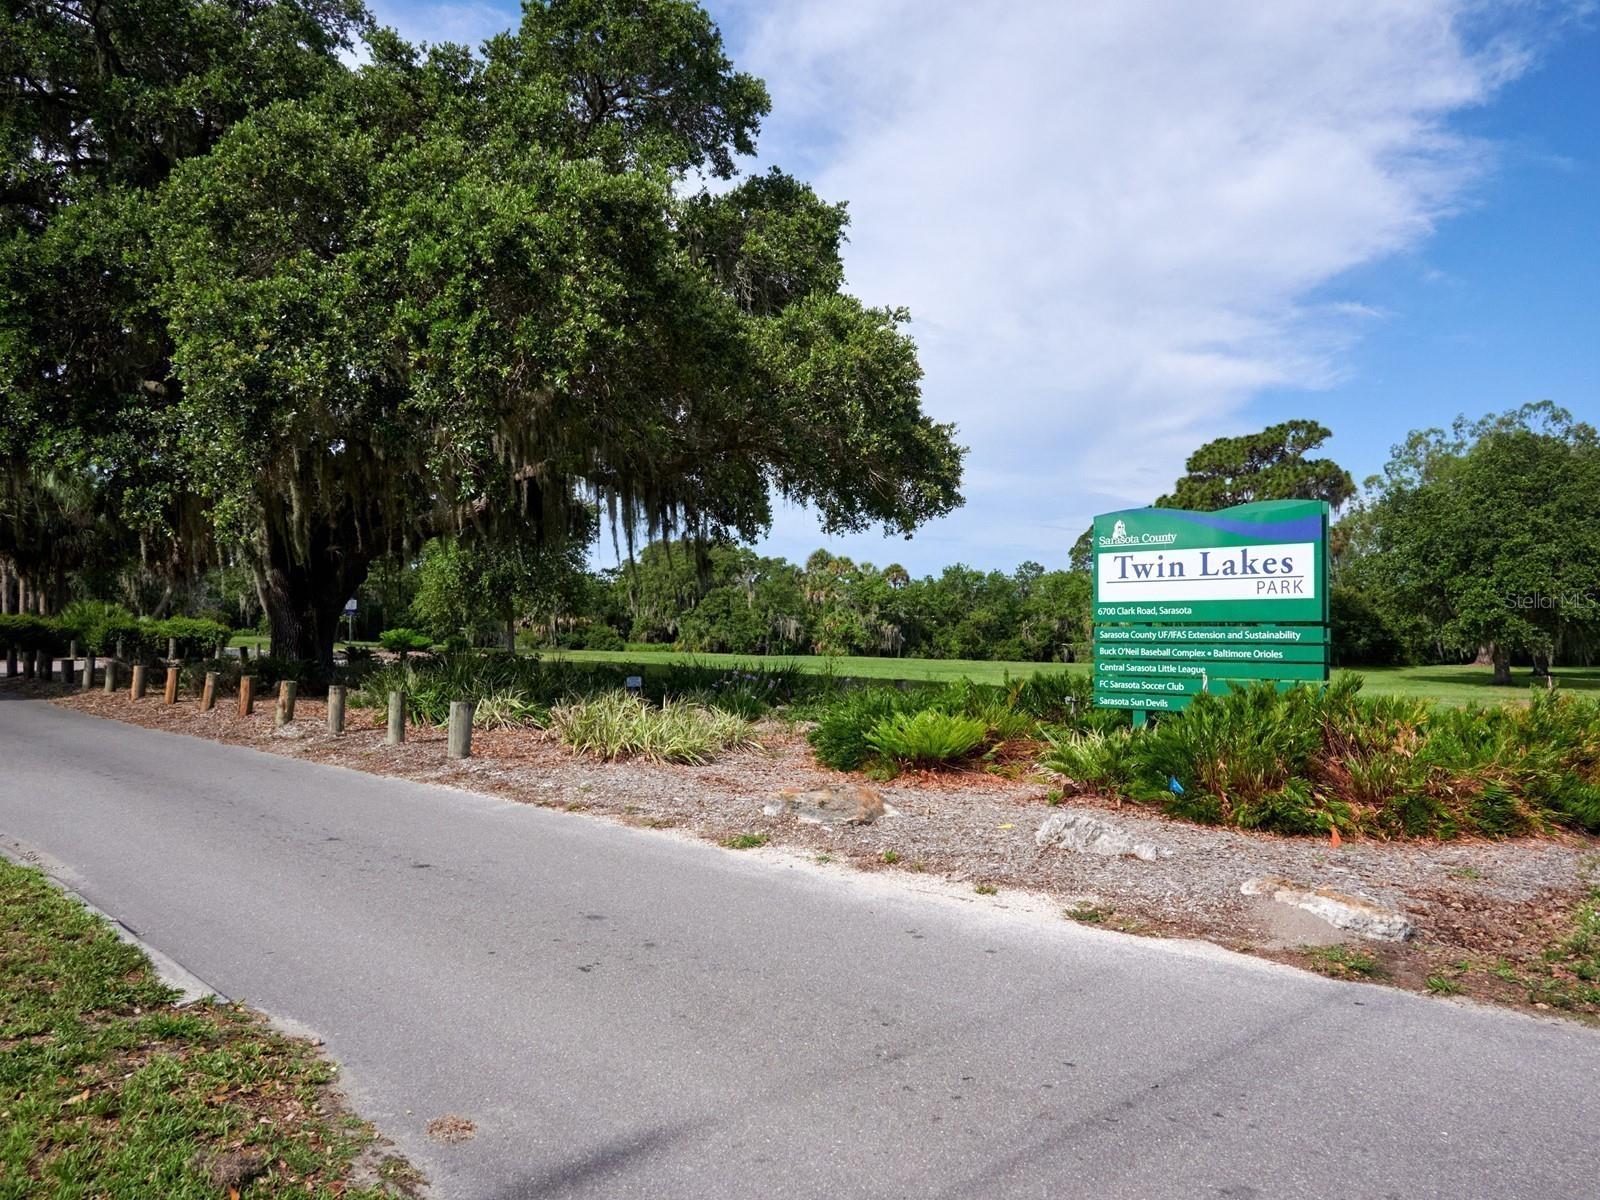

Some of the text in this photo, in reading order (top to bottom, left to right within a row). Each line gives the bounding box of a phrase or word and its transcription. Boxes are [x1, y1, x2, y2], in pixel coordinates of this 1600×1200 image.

[1099, 532, 1177, 546] Sarasota County
[1113, 548, 1294, 579] Twin Lakes
[1256, 579, 1304, 595] PARK
[1097, 606, 1192, 616] 6700 Clark Road, Sarasota
[1099, 631, 1301, 641] Sarasota County UF/IFAS Extension and Sustainability
[1099, 648, 1117, 656] Buck
[1140, 648, 1171, 657] Baseball
[1171, 648, 1206, 658] Complex
[1213, 649, 1252, 658] Baltimore
[1253, 649, 1283, 659] Orioles
[1099, 663, 1206, 675] Central Sarasota Little League
[1099, 680, 1185, 691] FC Sarasota Soccer Club
[1099, 697, 1169, 708] Sarasota Sun Devils
